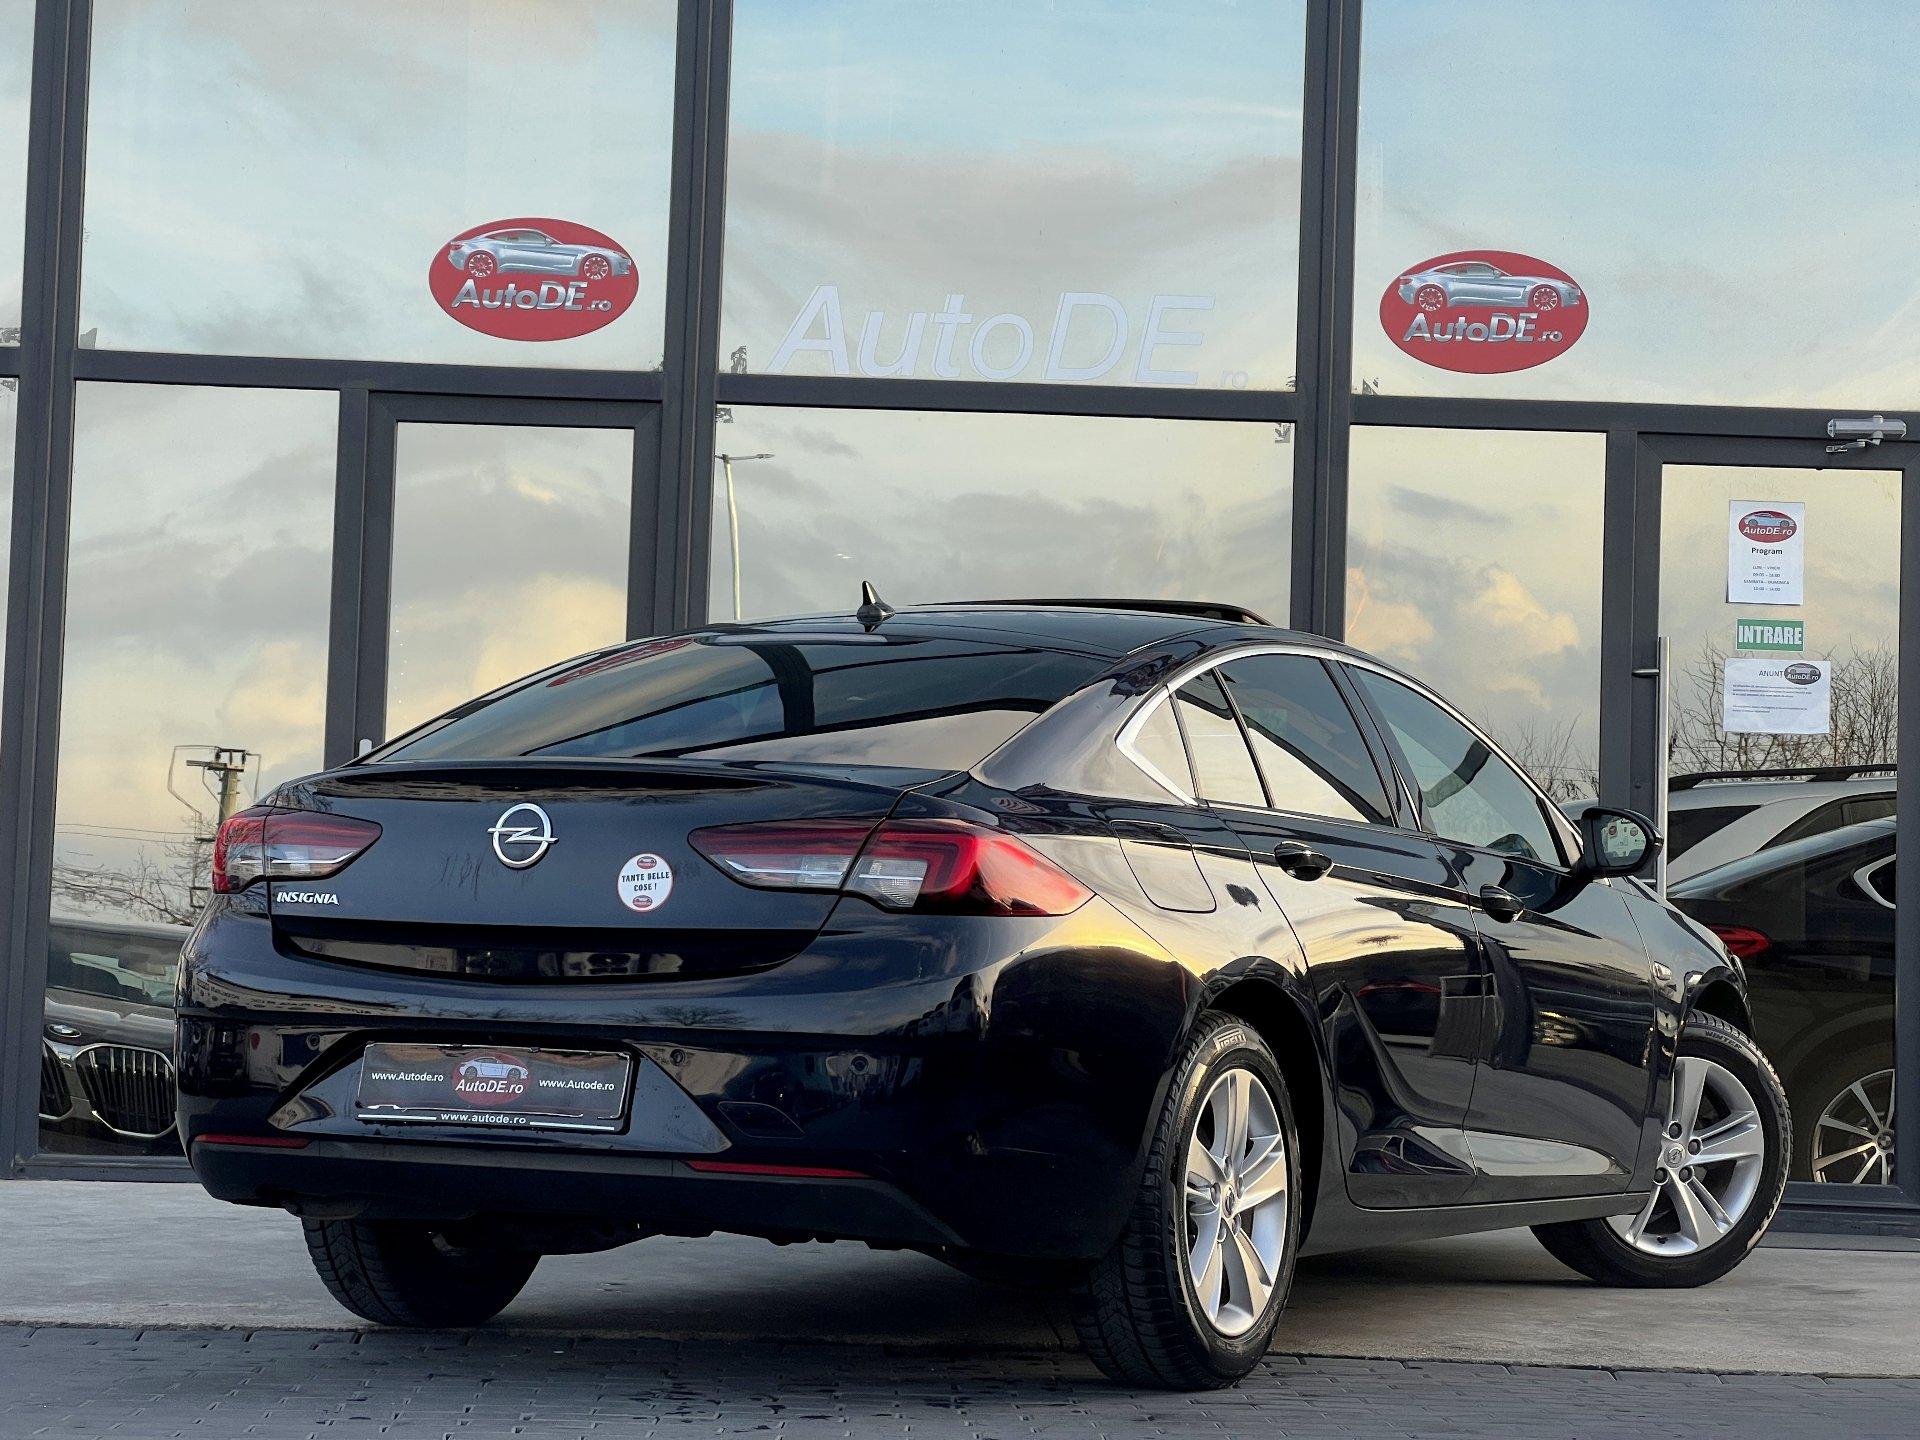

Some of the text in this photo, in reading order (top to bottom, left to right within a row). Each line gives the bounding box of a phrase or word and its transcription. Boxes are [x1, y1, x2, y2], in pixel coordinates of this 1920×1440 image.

[451, 278, 613, 312] AutoDE.ro
[1402, 312, 1564, 343] AutoDE.ro
[1743, 526, 1793, 536] AutoDE.ro
[1751, 547, 1783, 556] Program
[1738, 625, 1803, 645] INTRARE
[621, 871, 670, 883] TANTE BELLE
[633, 883, 652, 892] COSE
[276, 891, 340, 905] INSIGNIA
[1705, 1030, 1742, 1052] WINTER
[371, 1071, 444, 1082] www.Autode.ro
[454, 1078, 524, 1095] AutoDE.ro
[538, 1078, 615, 1091] www.Autode.ro
[440, 1112, 527, 1125] www.autode.ro
